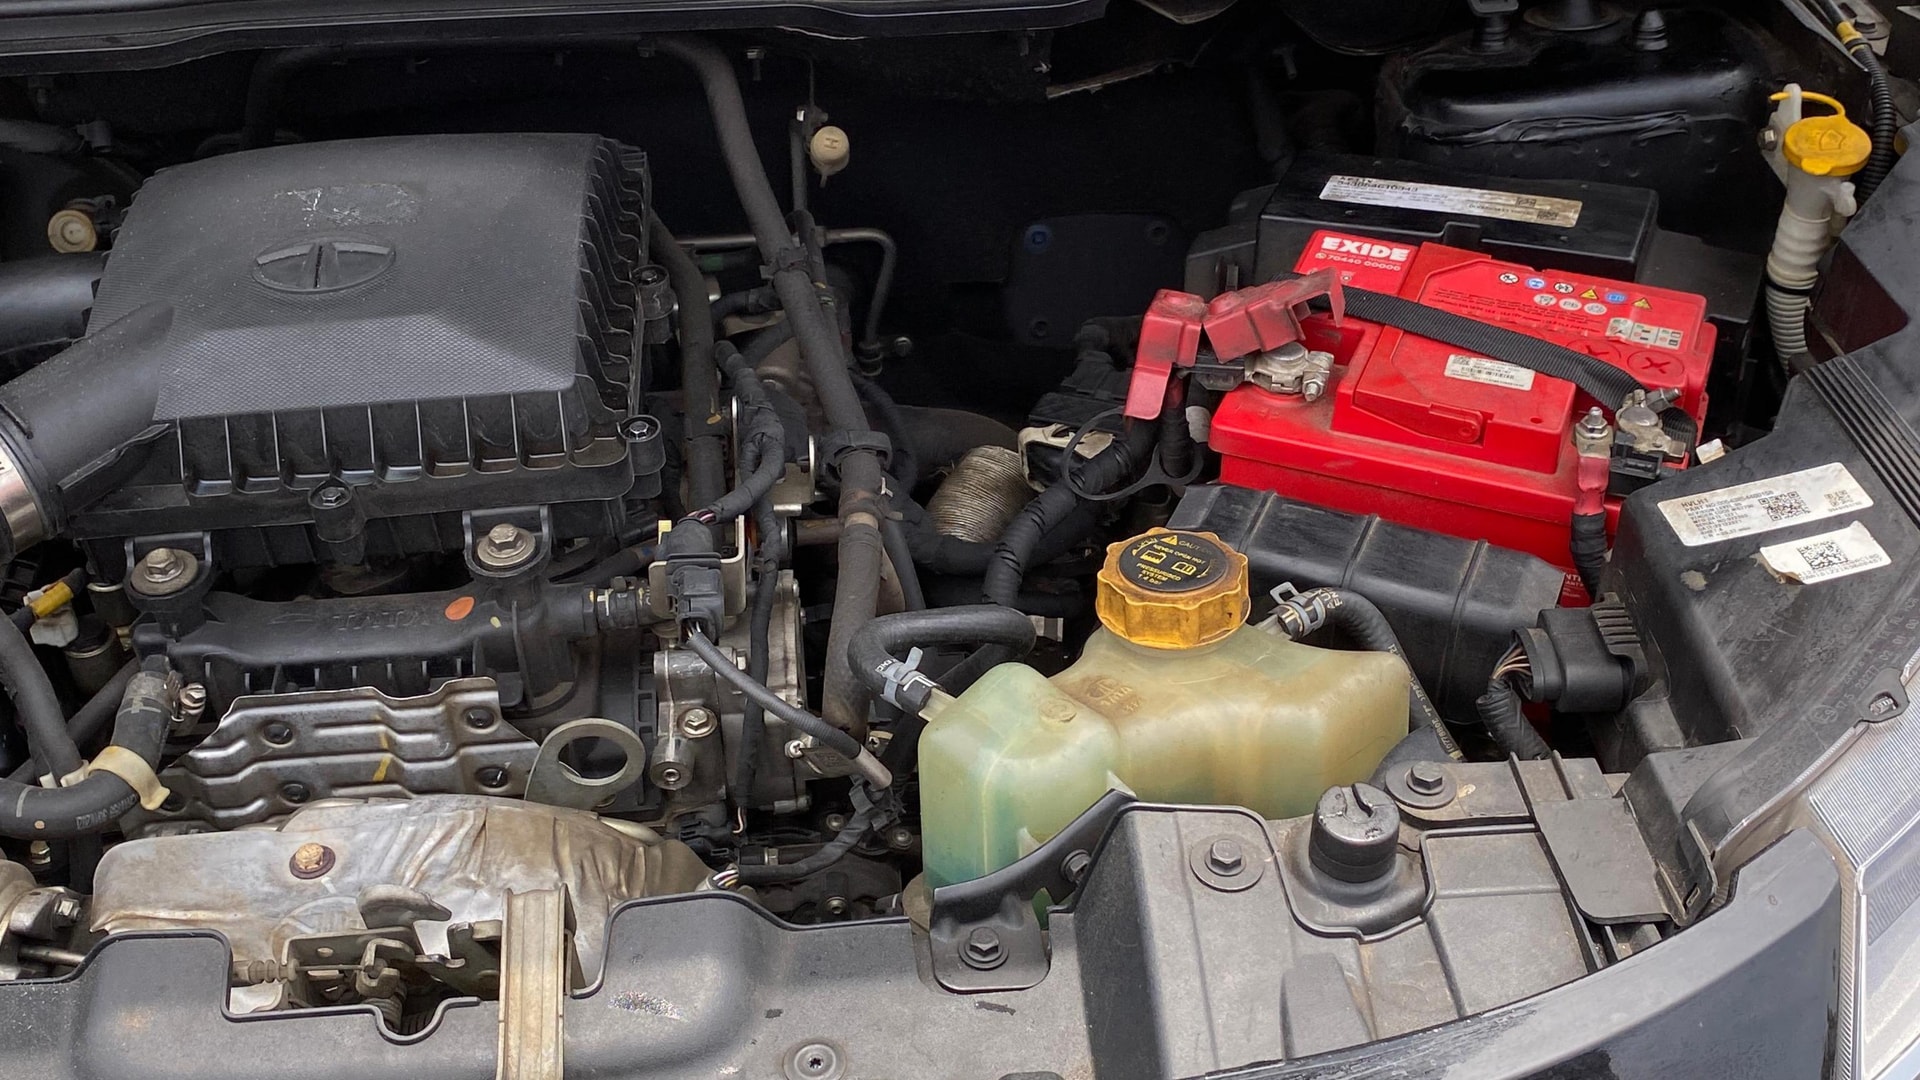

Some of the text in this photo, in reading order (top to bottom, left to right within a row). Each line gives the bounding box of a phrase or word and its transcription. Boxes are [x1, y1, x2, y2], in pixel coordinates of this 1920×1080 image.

[1321, 236, 1410, 262] EXIDE
[1327, 254, 1362, 265] 70440
[1364, 260, 1401, 271] 00000
